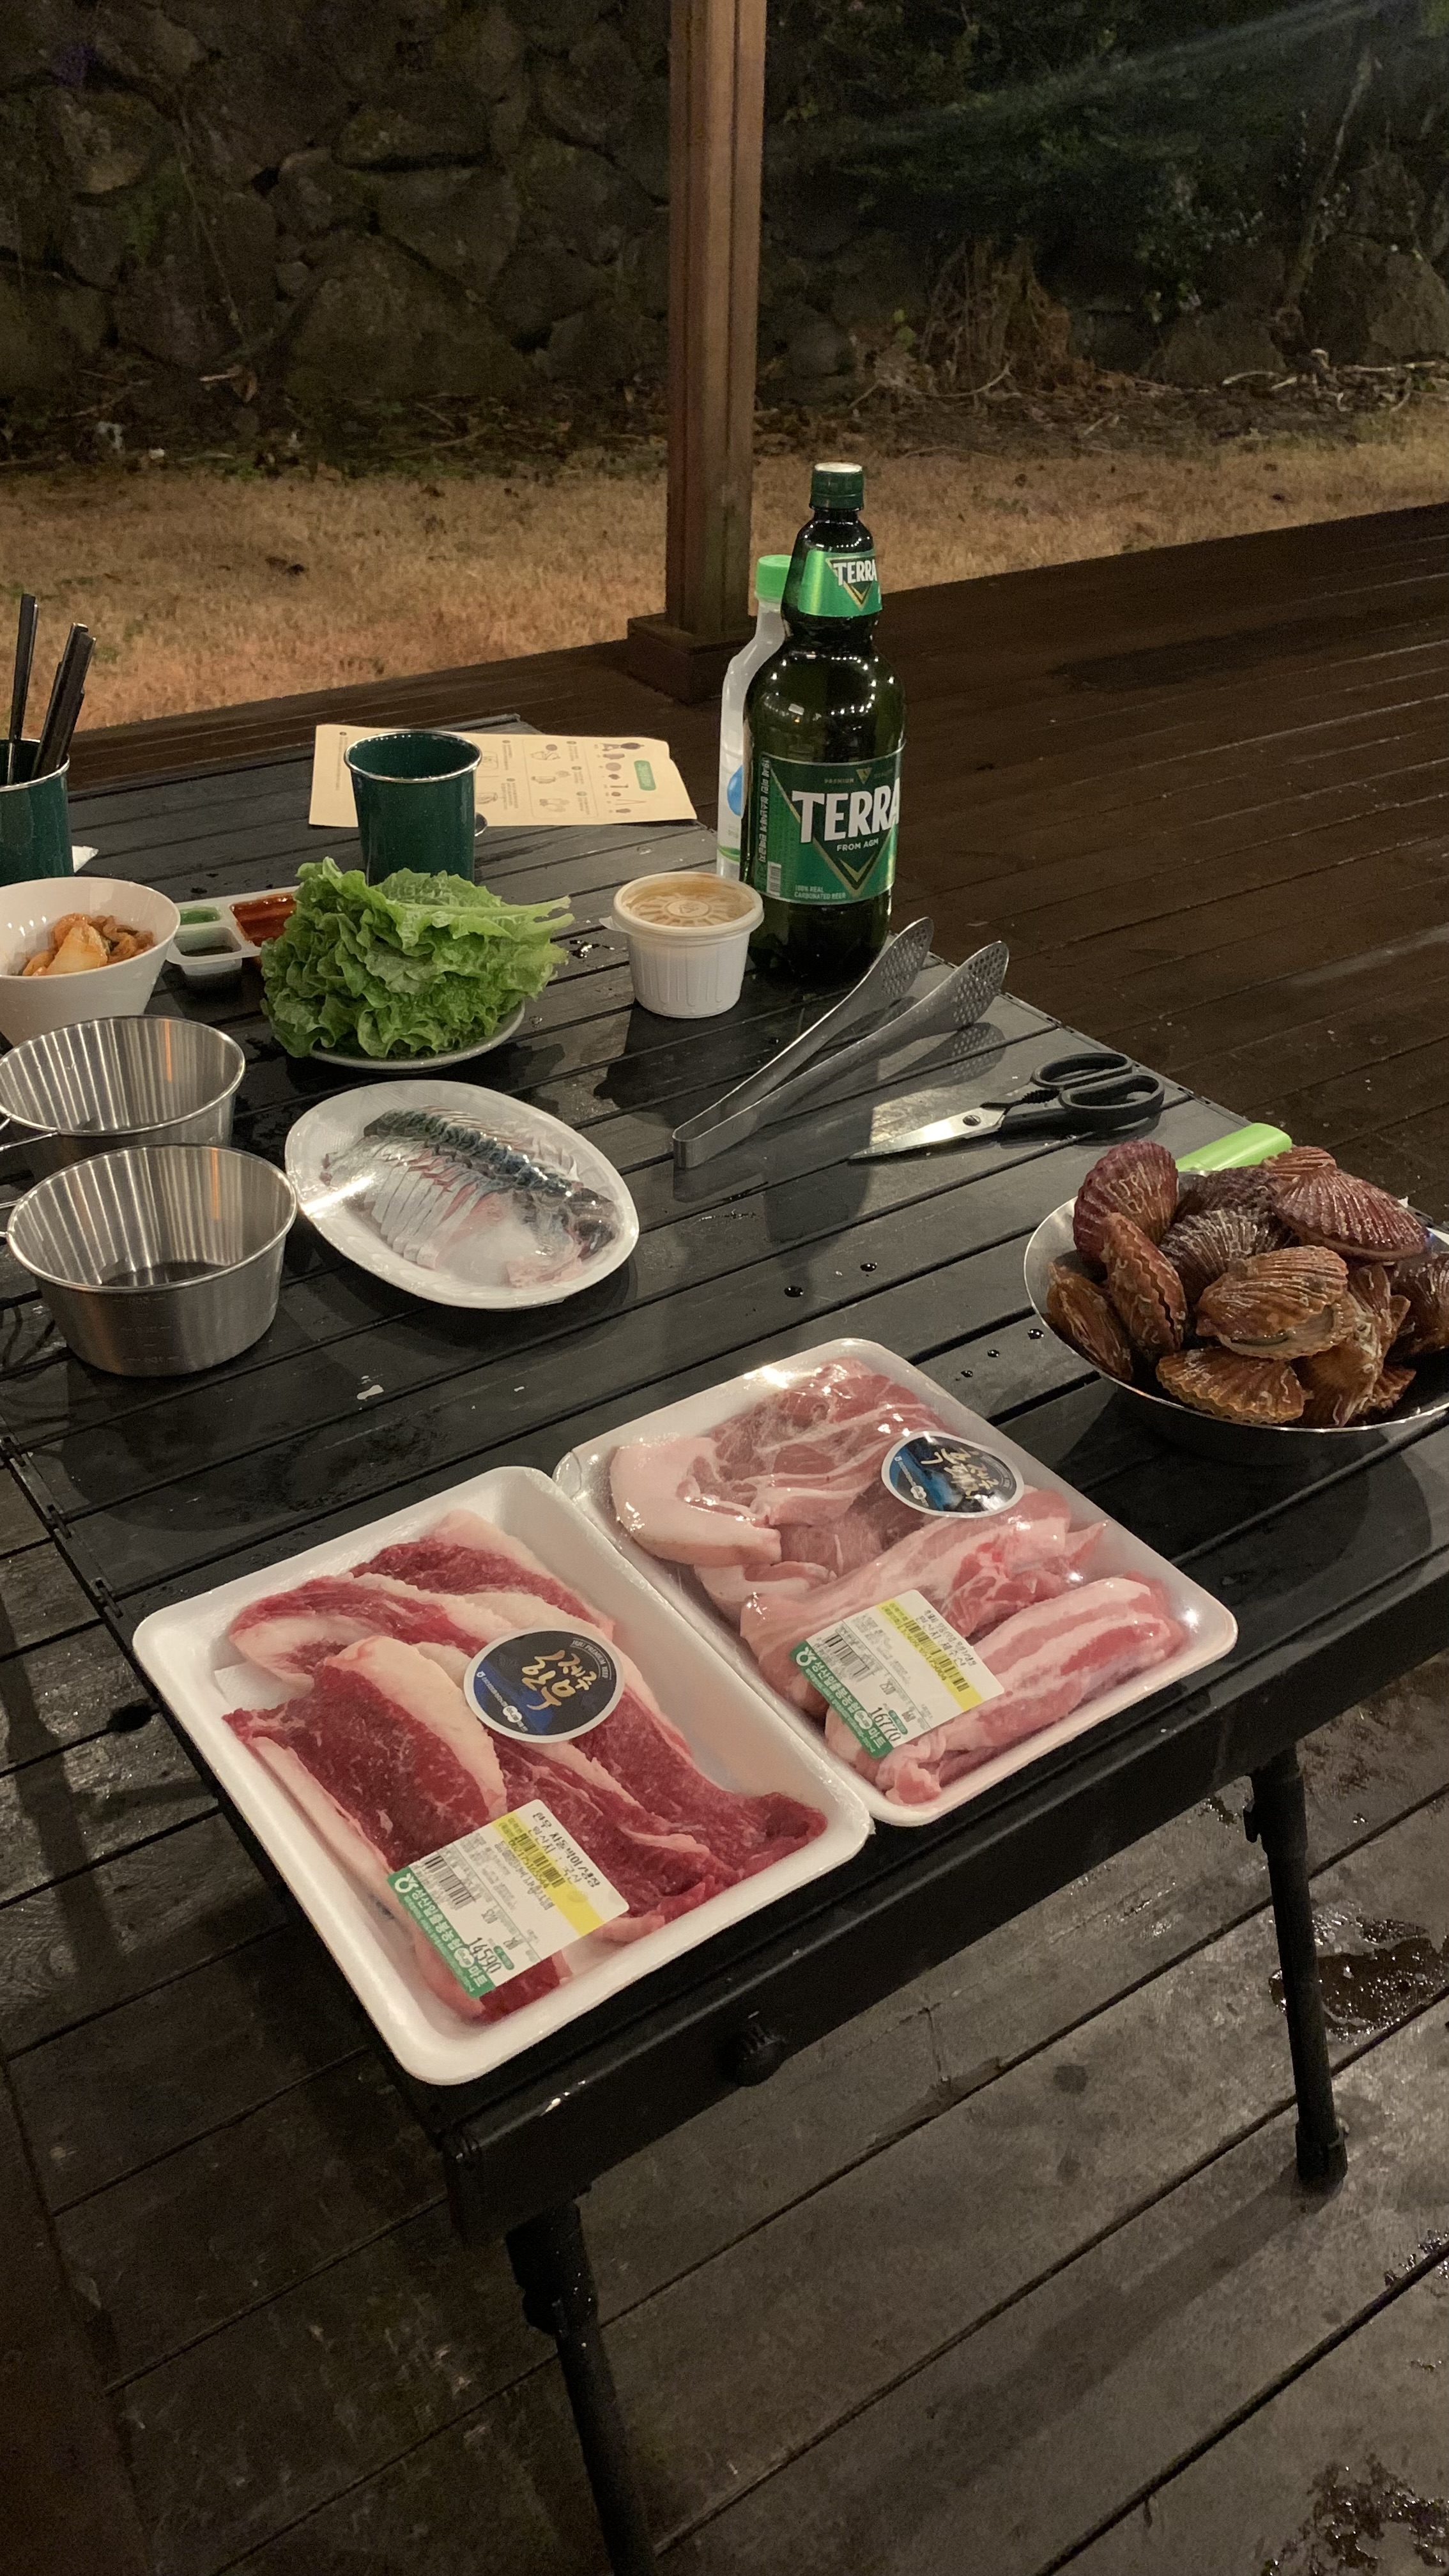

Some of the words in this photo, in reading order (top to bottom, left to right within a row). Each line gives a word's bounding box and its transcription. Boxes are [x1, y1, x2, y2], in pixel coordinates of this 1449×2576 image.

[833, 559, 878, 586] TERRA
[792, 778, 900, 843] TERRA
[836, 841, 861, 852] FROM
[863, 838, 879, 849] AGM
[521, 1650, 576, 1711] 한우
[558, 1652, 597, 1690] 제주
[868, 1728, 887, 1749] 마트
[870, 1707, 901, 1742] 16770
[528, 1826, 556, 1855] 원산지
[468, 1937, 502, 1974] 14590
[468, 1965, 488, 1988] 마트
